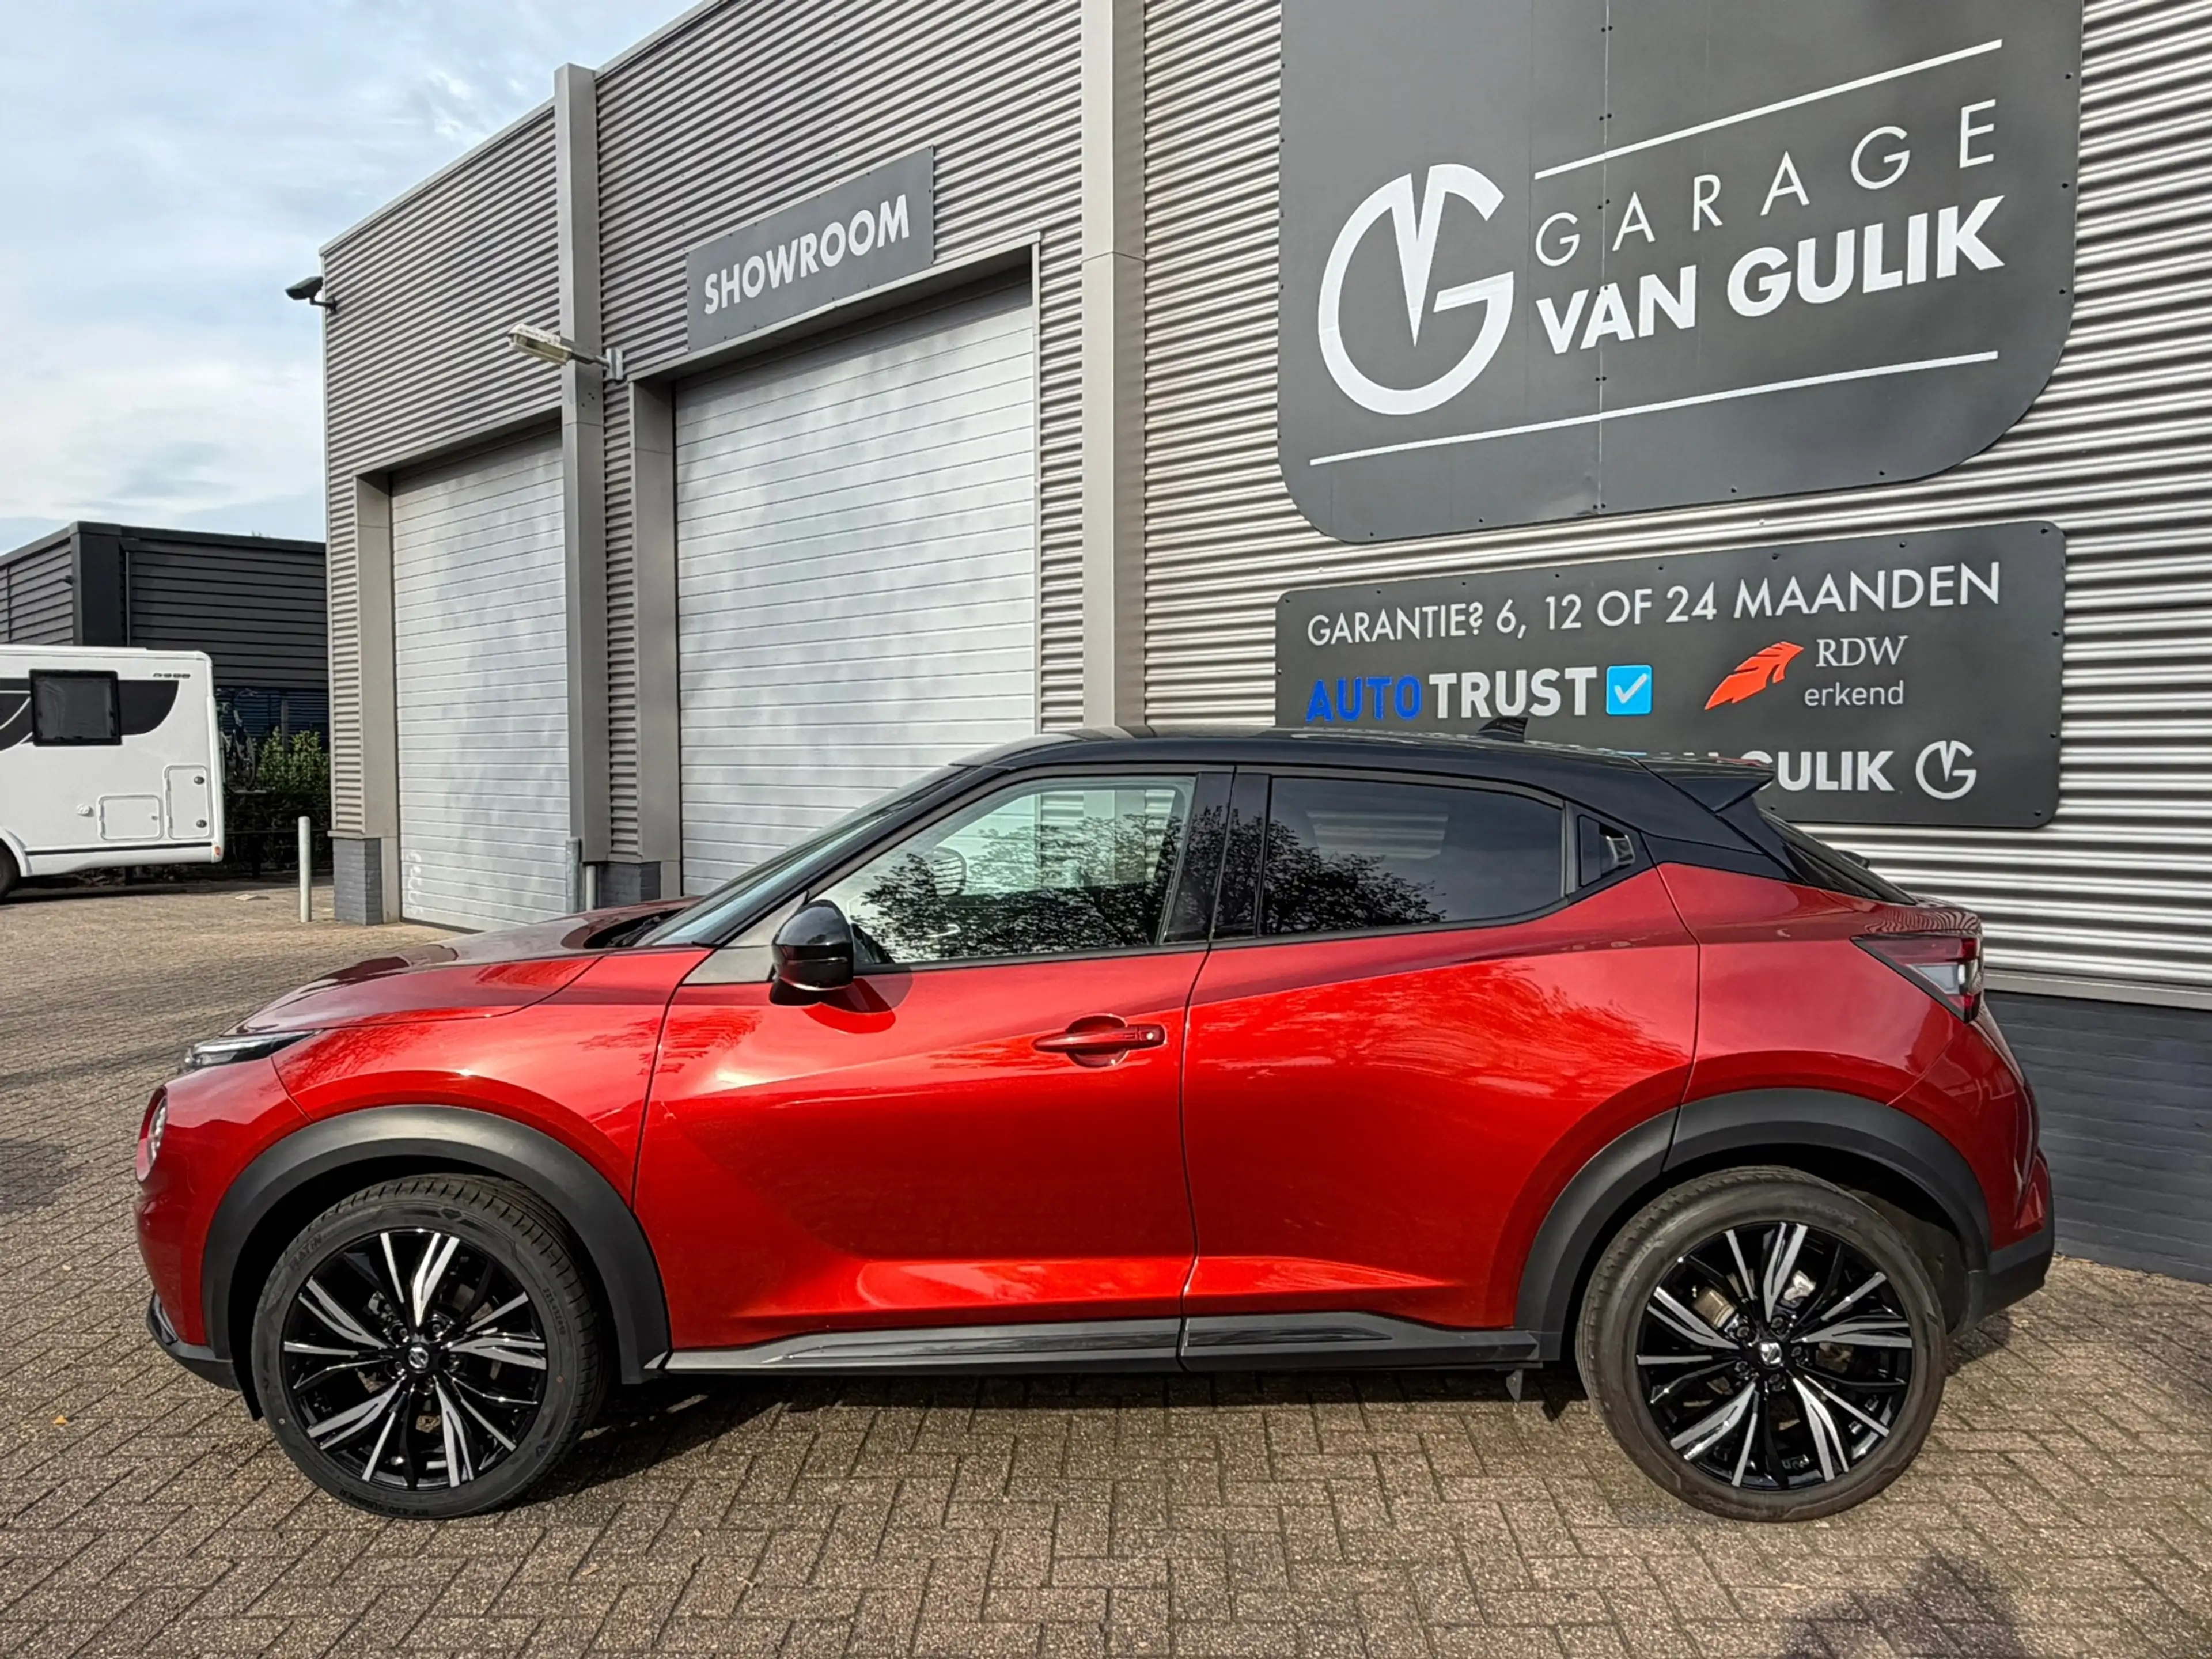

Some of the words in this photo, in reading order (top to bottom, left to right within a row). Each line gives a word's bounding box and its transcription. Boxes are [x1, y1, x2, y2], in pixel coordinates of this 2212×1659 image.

[1535, 99, 1997, 267] GARAGE
[704, 194, 910, 315] SHOWROOM
[1536, 264, 1697, 354] VAN
[1728, 195, 2005, 317] GULIK
[1307, 601, 1483, 646] GARANTIE?
[1496, 599, 1527, 639] 6,
[1545, 594, 1582, 630] 12
[1597, 589, 1652, 627] OF
[1666, 581, 1717, 623] 24
[1734, 562, 1999, 618] MAANDEN
[1804, 680, 1904, 706] erkend
[1815, 635, 1909, 667] RDW
[1740, 751, 1895, 791] ULIK
